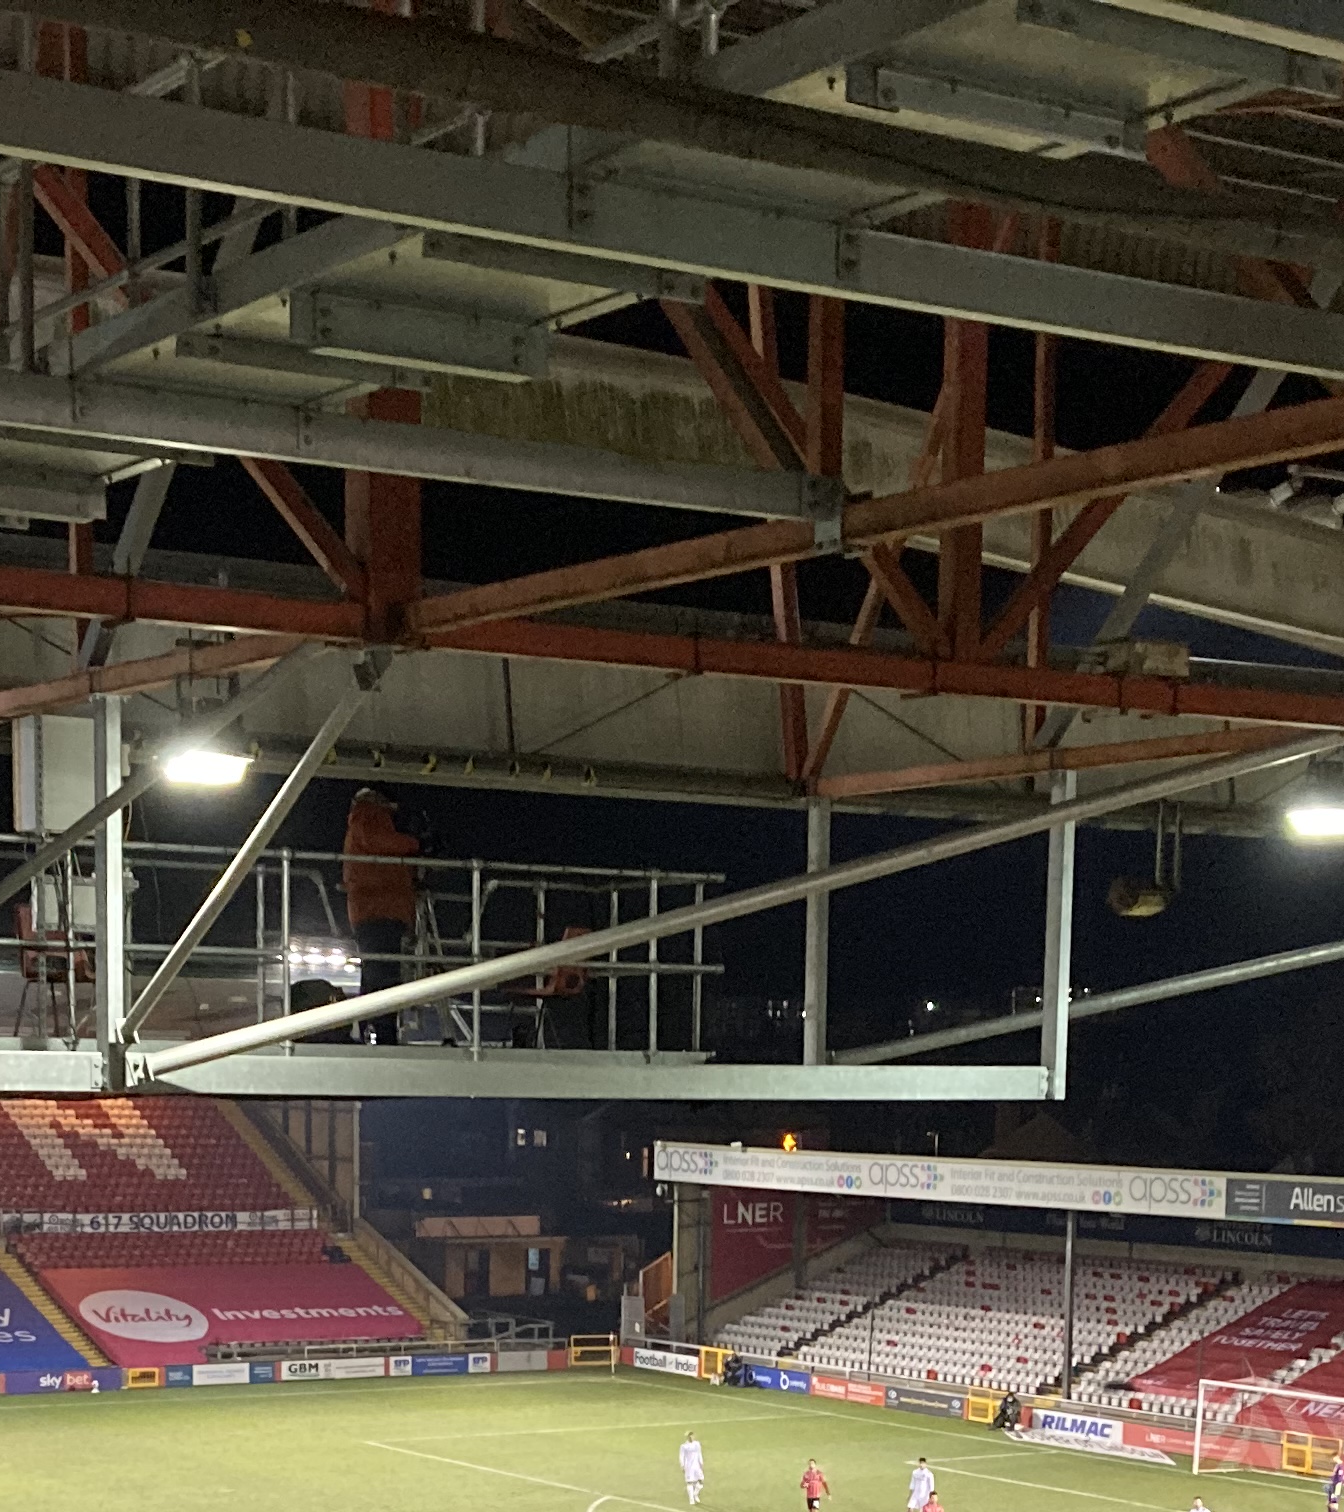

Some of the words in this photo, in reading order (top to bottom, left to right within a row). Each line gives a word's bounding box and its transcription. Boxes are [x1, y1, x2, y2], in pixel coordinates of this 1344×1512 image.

[657, 1149, 699, 1179] apss
[761, 1158, 775, 1169] and
[826, 1159, 862, 1174] Solutions
[869, 1161, 919, 1194] apss
[951, 1168, 980, 1181] Interior
[984, 1170, 999, 1182] Fit
[1002, 1170, 1014, 1183] and
[1016, 1170, 1075, 1186] Construction
[1077, 1174, 1123, 1188] Solutions
[1129, 1176, 1191, 1212] apss
[723, 1200, 784, 1225] LNER
[1212, 1229, 1273, 1247] LINCOLN
[92, 1305, 193, 1328] Vitality
[210, 1304, 404, 1322] Investments
[288, 1362, 319, 1374] GBM
[634, 1350, 667, 1368] Football
[675, 1357, 698, 1372] Index
[39, 1373, 63, 1389] sky
[66, 1373, 89, 1386] bet
[1042, 1413, 1113, 1438] RILMAC
